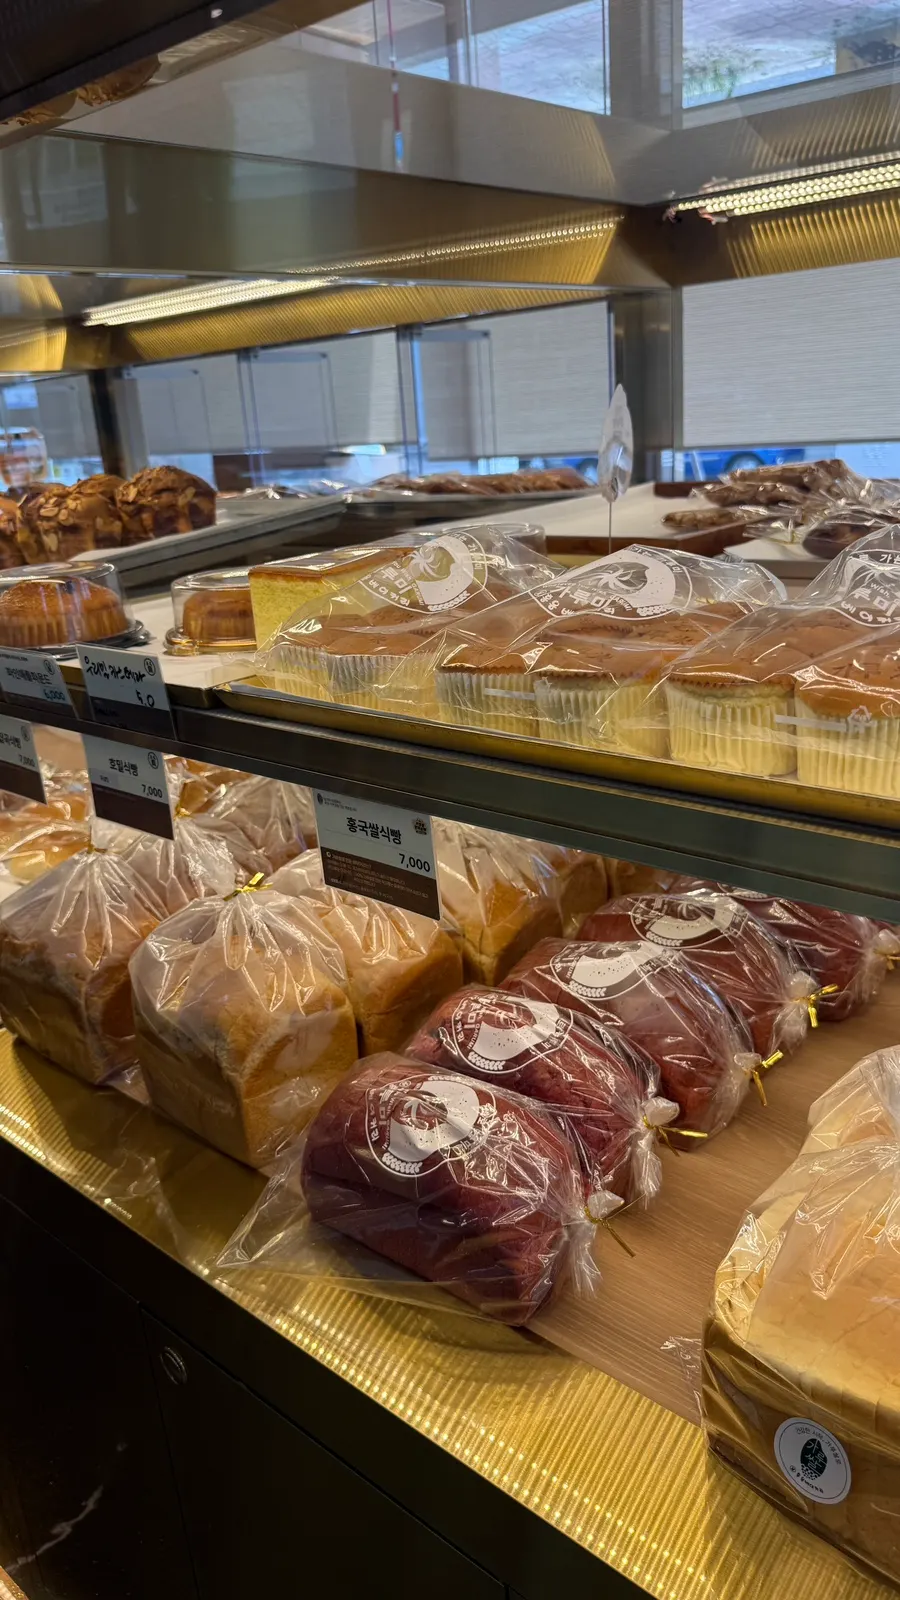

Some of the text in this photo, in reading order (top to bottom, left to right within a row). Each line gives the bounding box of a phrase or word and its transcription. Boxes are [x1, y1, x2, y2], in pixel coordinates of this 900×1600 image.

[108, 757, 139, 777] 호밀식빵
[141, 783, 163, 799] 7,000
[346, 817, 402, 845] 홍국쌀식빵
[398, 853, 431, 873] 7,000
[466, 1023, 480, 1050] GARUMI
